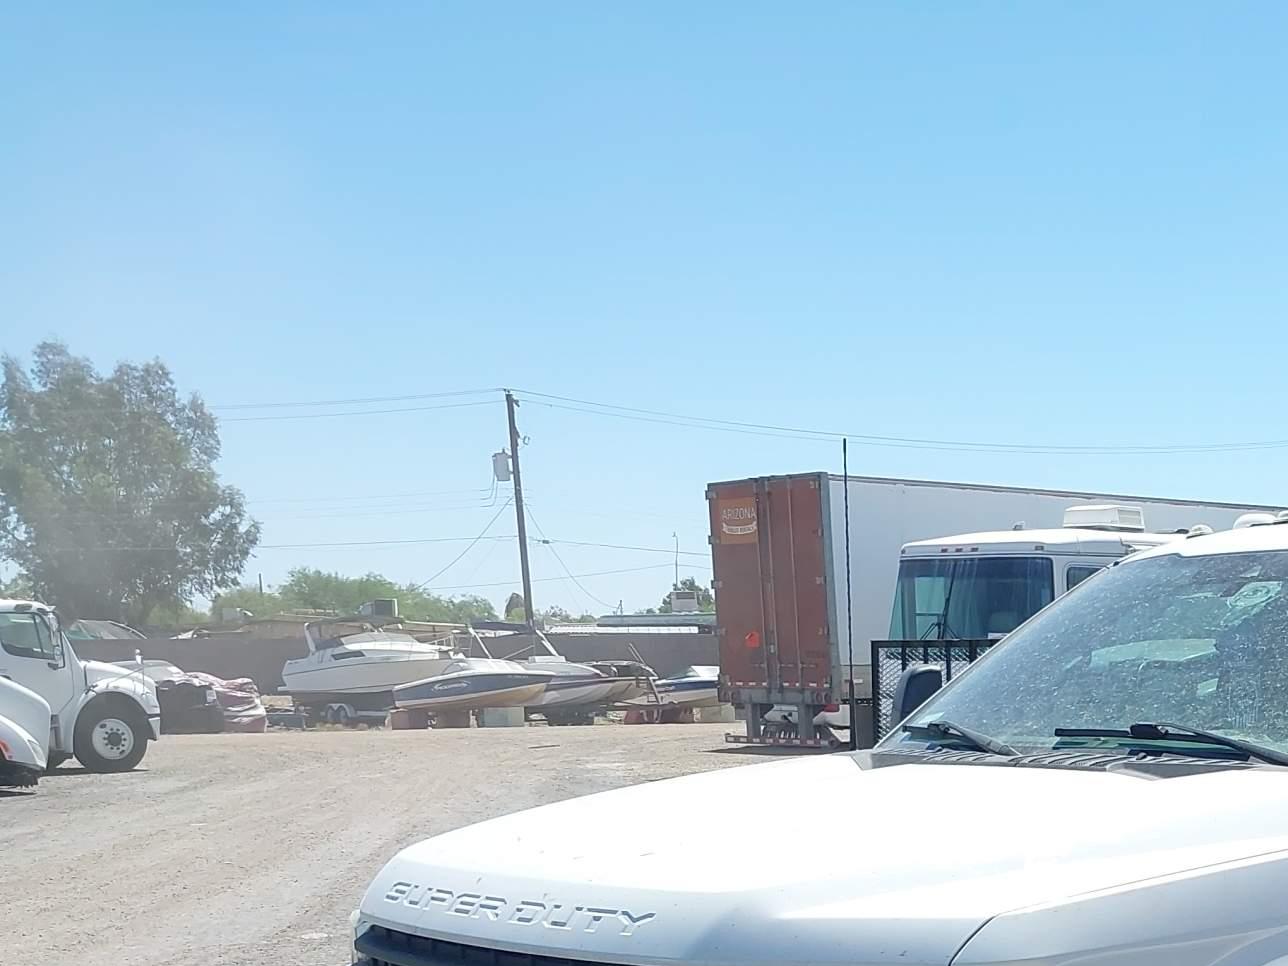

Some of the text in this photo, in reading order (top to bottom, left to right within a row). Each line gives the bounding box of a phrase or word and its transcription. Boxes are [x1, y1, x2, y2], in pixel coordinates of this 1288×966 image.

[722, 507, 757, 520] ARIZONA
[385, 880, 657, 936] SUPER DUTY
